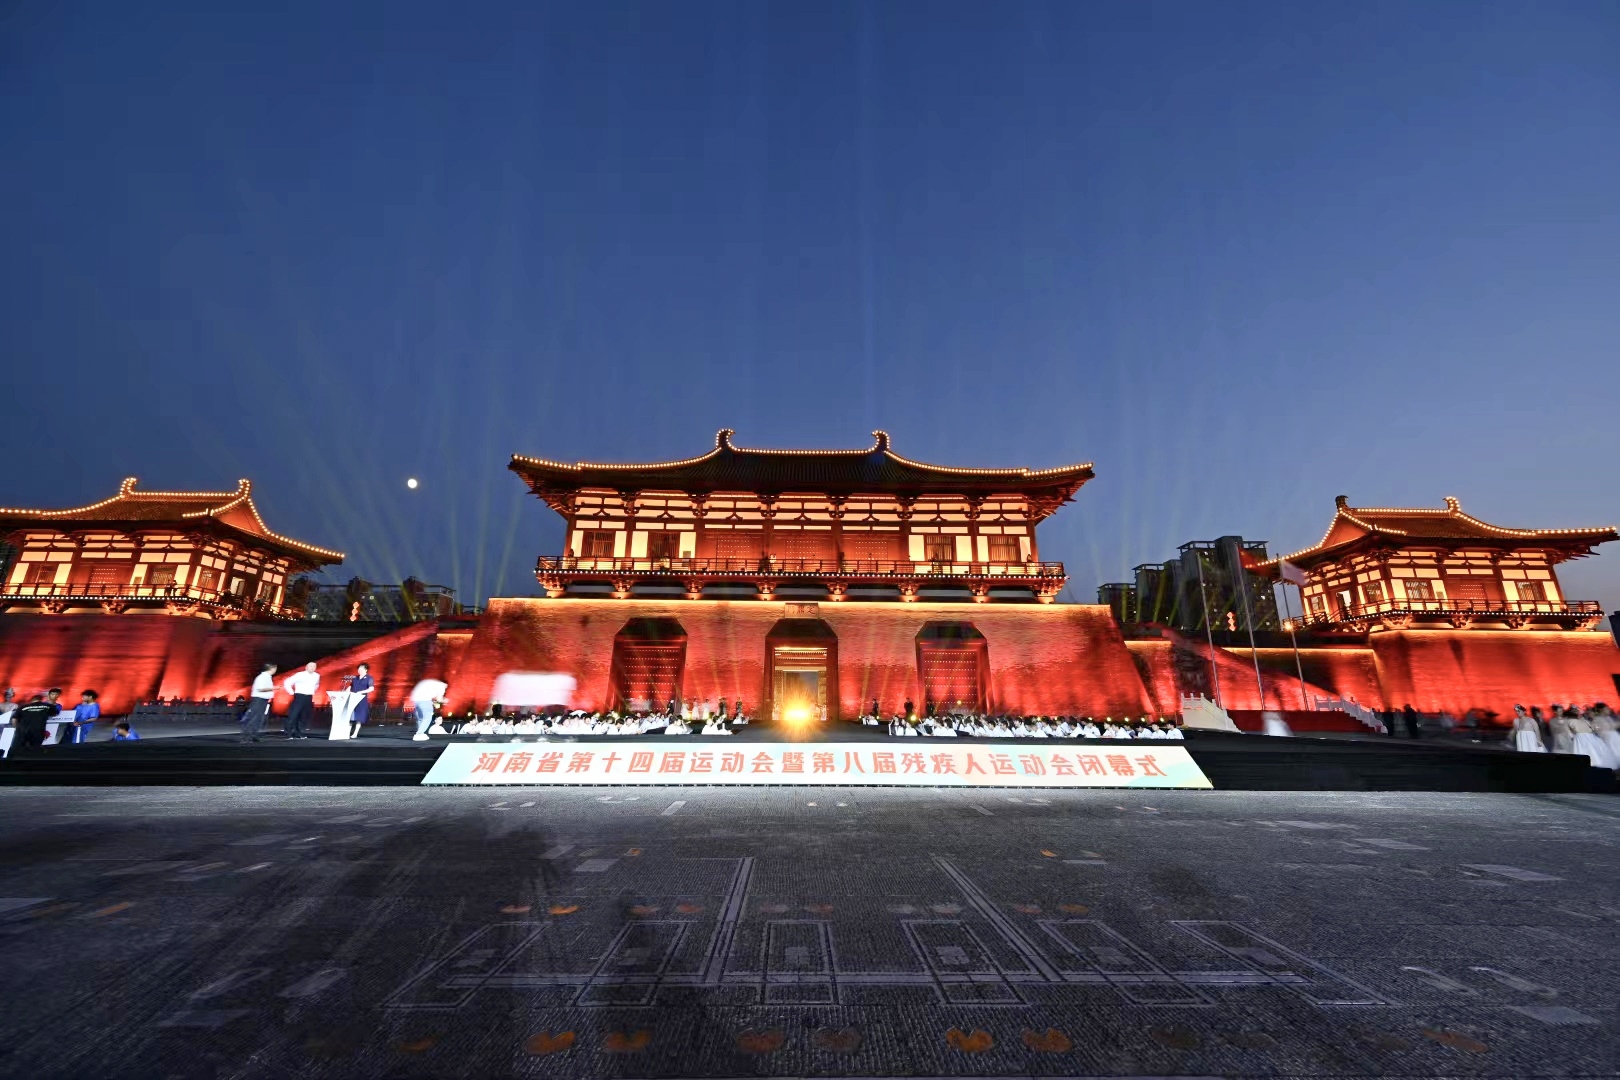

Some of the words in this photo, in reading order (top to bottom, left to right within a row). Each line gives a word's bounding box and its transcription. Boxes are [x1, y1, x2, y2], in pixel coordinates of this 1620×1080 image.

[471, 751, 1168, 776] 河南省第十四届运动会暨第八届残疾人运动会闭幕式
